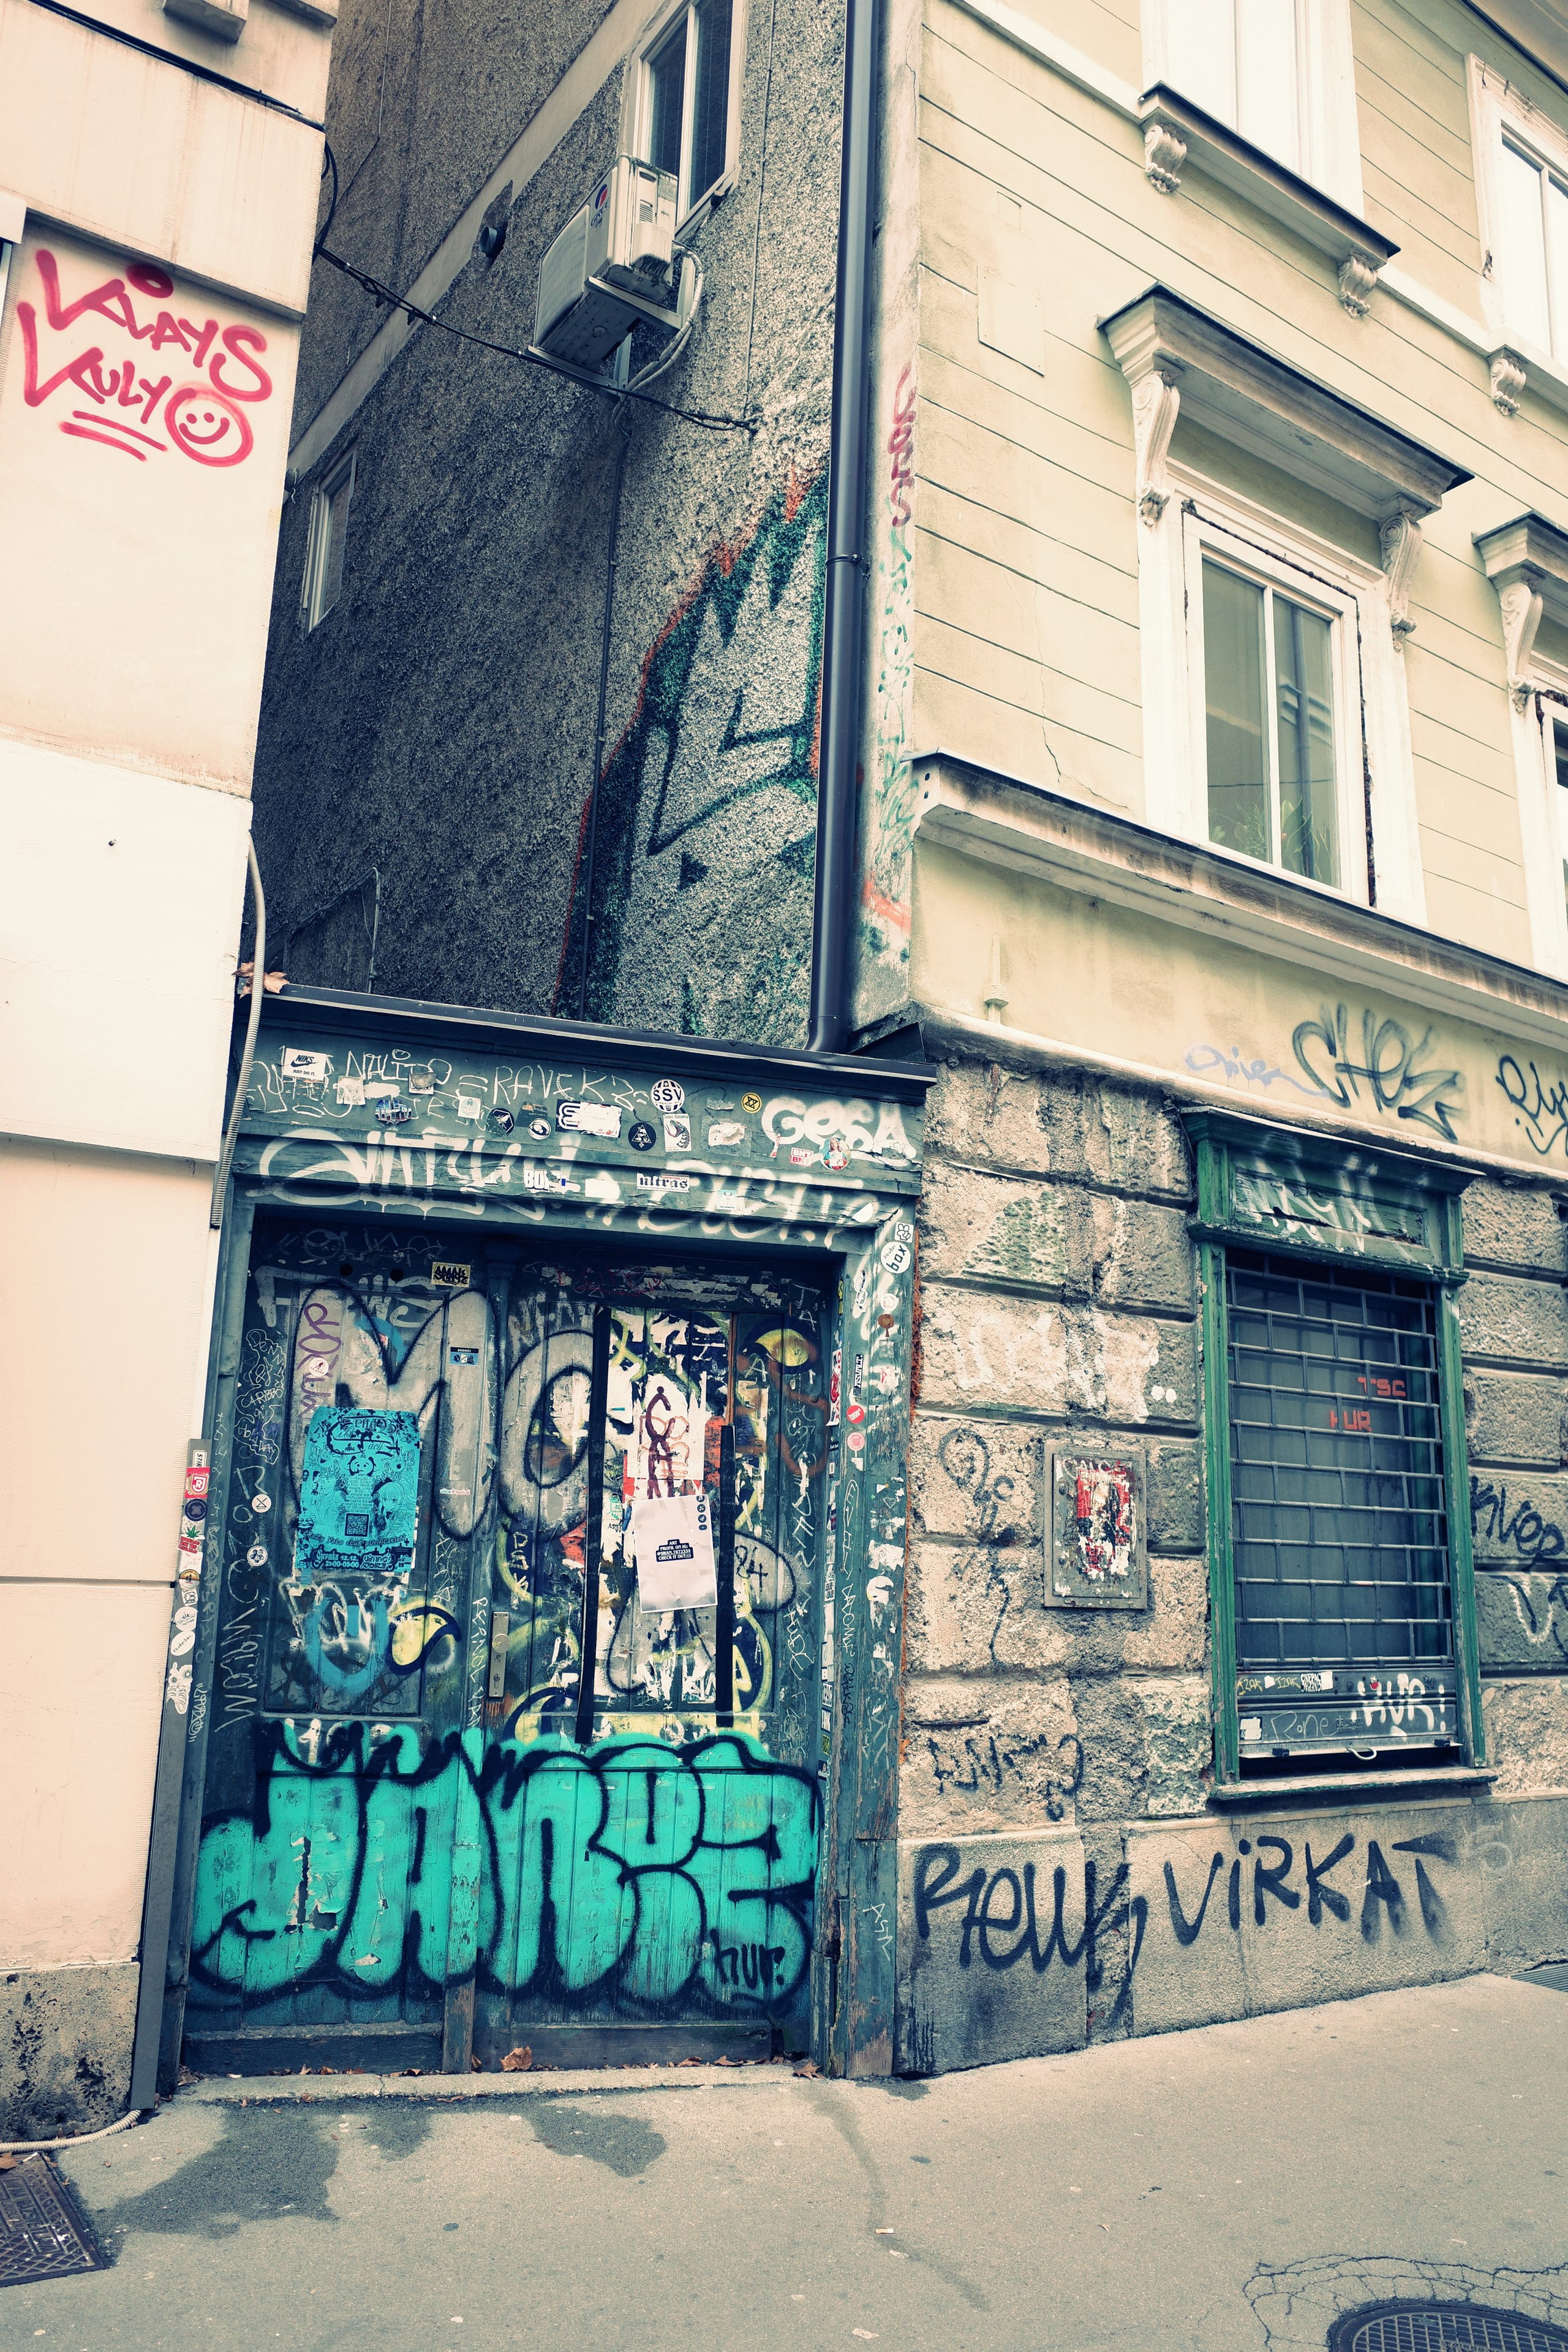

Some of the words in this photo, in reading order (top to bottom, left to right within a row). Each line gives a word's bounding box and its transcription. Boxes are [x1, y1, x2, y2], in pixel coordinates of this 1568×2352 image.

[653, 1088, 682, 1101] SSV
[793, 1148, 812, 1157] BNT
[792, 1155, 812, 1165] BNT
[883, 1245, 896, 1259] zauber
[1357, 1376, 1408, 1397] TSC
